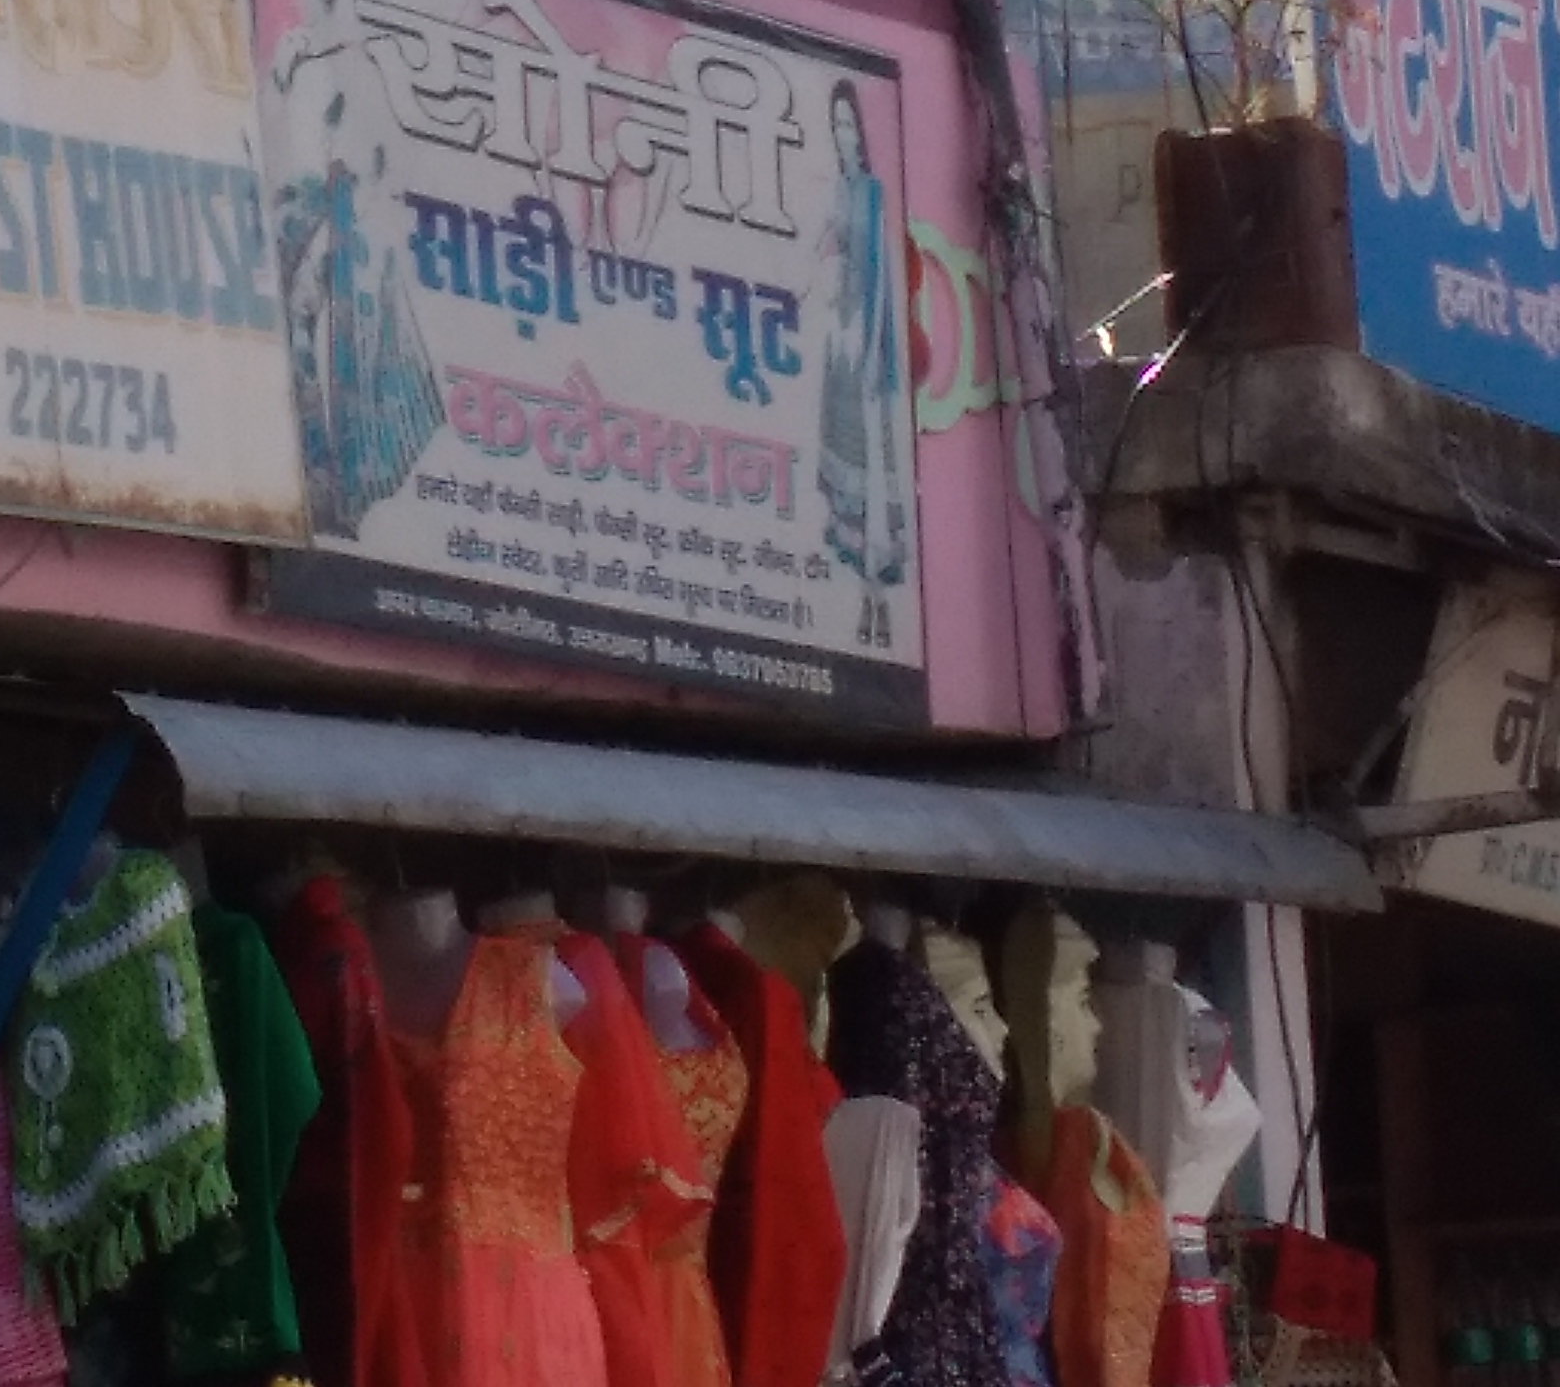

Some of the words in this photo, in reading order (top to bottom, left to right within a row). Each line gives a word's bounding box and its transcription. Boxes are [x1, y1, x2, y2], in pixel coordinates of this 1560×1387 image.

[59, 135, 279, 339] HOUSE
[402, 193, 580, 342] साड़ी
[587, 247, 680, 321] एण्ड
[691, 263, 803, 407] सूट
[6, 344, 178, 456] 222734
